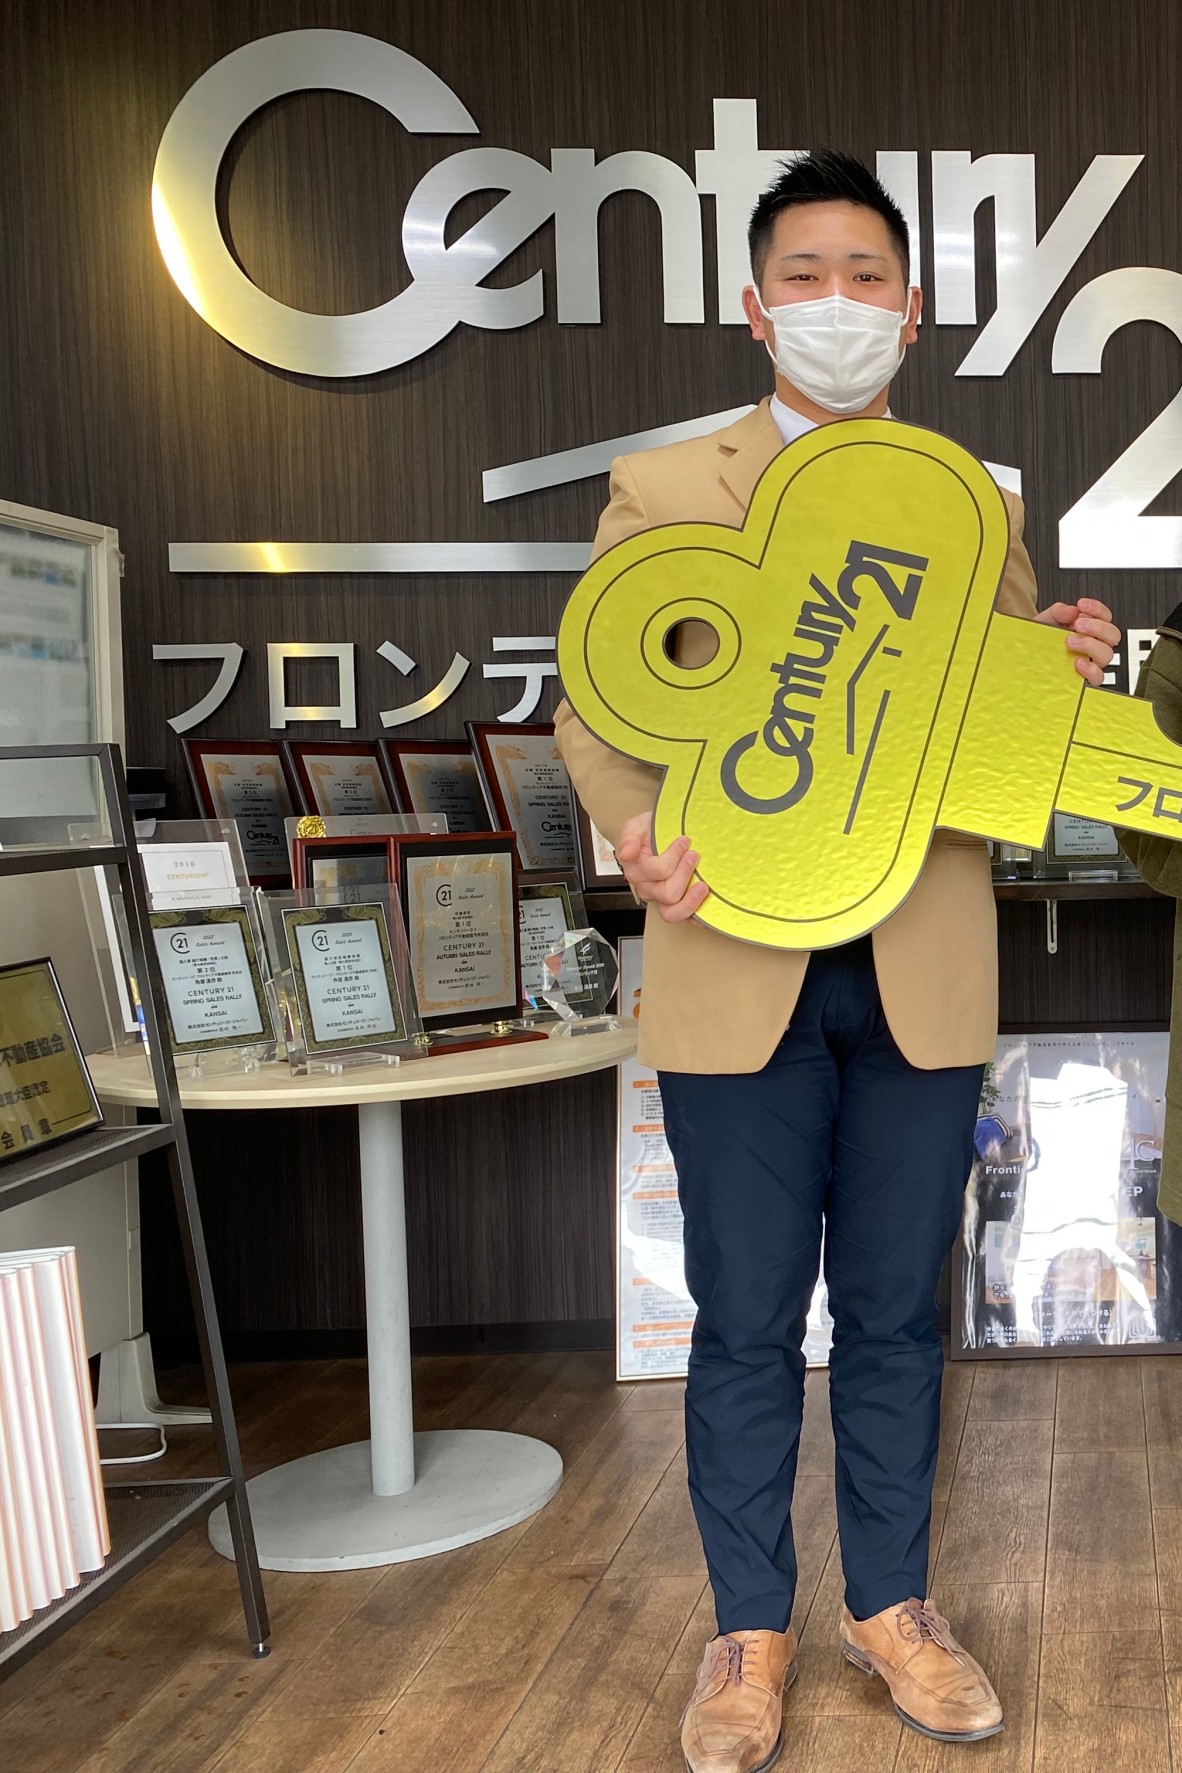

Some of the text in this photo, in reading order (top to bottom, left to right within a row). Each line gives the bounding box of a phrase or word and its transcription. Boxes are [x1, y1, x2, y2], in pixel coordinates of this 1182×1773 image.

[720, 539, 929, 815] Century 21
[443, 942, 476, 951] CENTURY
[436, 952, 458, 960] AUTUMN
[188, 986, 225, 997] CENTURY
[327, 985, 361, 995] CENTURY
[183, 994, 242, 1006] SPRING SALES RALLY
[204, 1010, 228, 1018] KANSAI
[0, 1033, 65, 1068] 不動産協会
